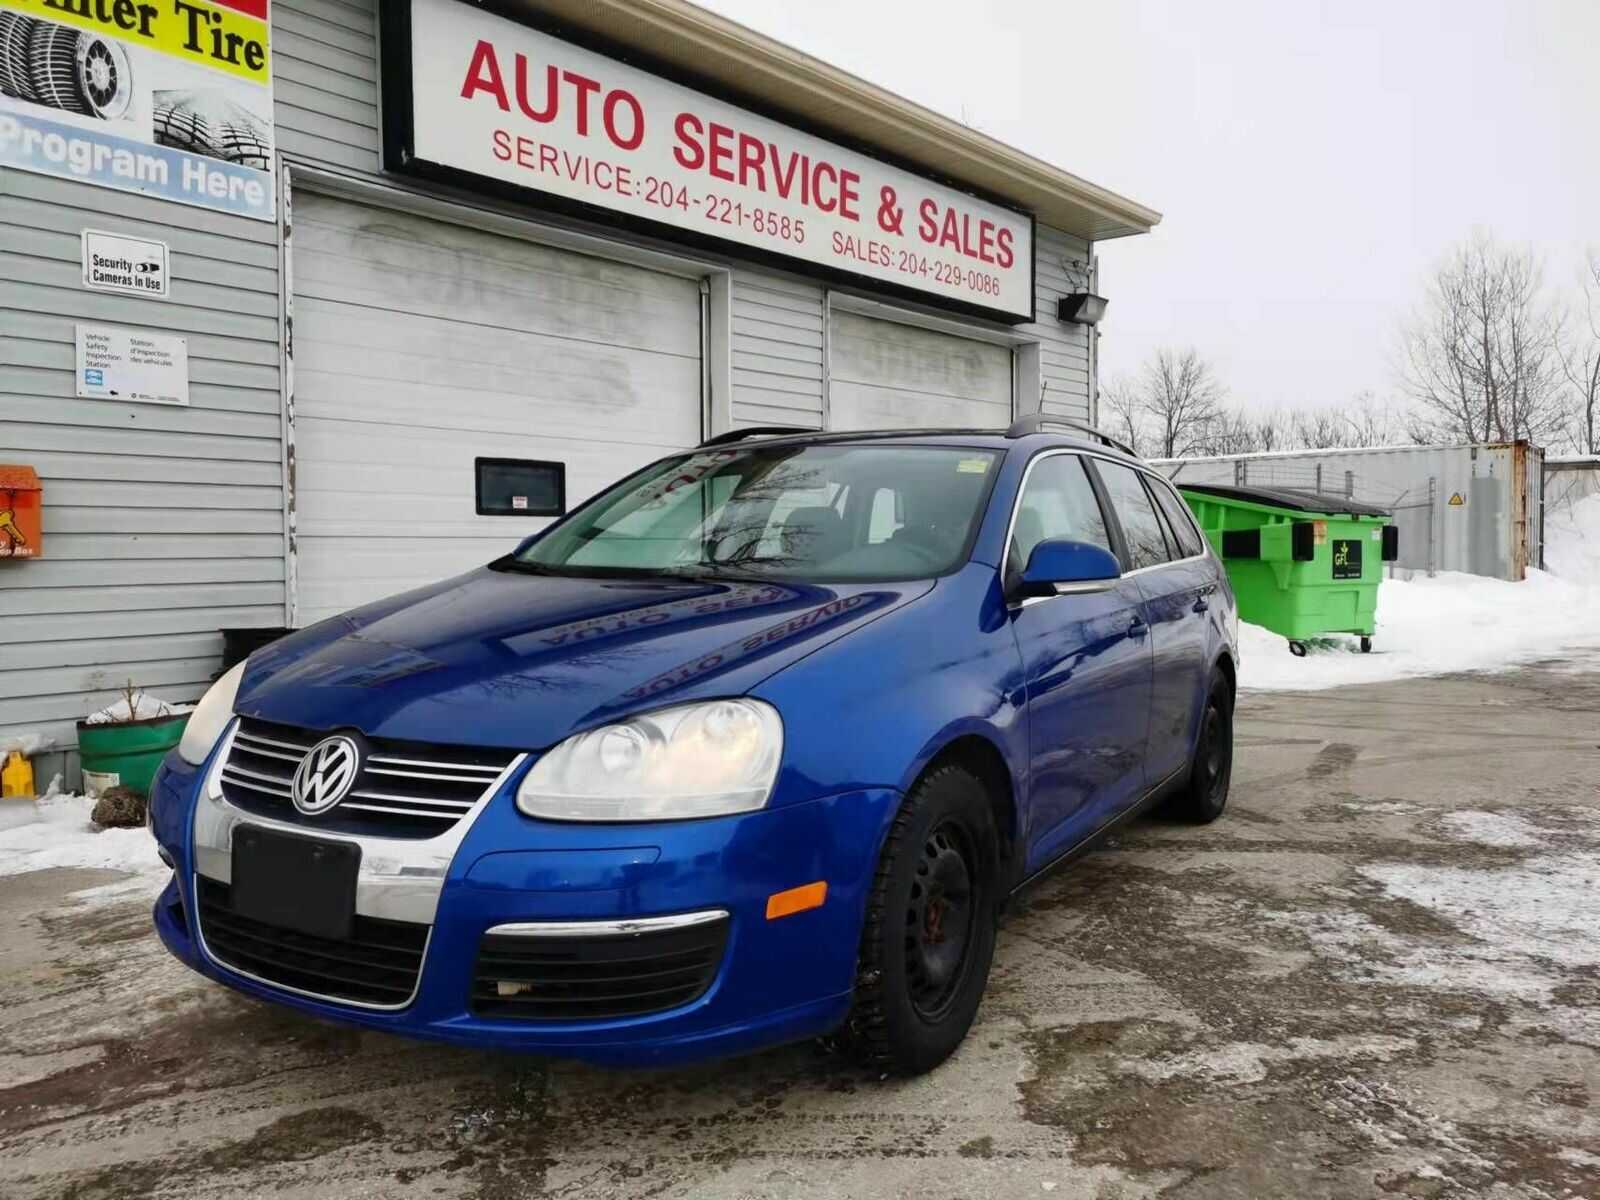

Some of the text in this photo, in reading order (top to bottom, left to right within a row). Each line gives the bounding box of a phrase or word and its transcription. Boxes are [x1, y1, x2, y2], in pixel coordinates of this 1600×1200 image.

[175, 0, 265, 71] Tire
[0, 114, 265, 206] Program Here
[460, 39, 1014, 269] AUTO SERVICE & SALES
[93, 254, 132, 273] Security
[93, 269, 132, 286] Cameras
[145, 277, 160, 290] Use
[86, 333, 110, 341] Vehicle
[130, 338, 154, 347] Station
[86, 342, 108, 352] Safety
[86, 352, 121, 361] Inspection
[86, 360, 111, 369] Station
